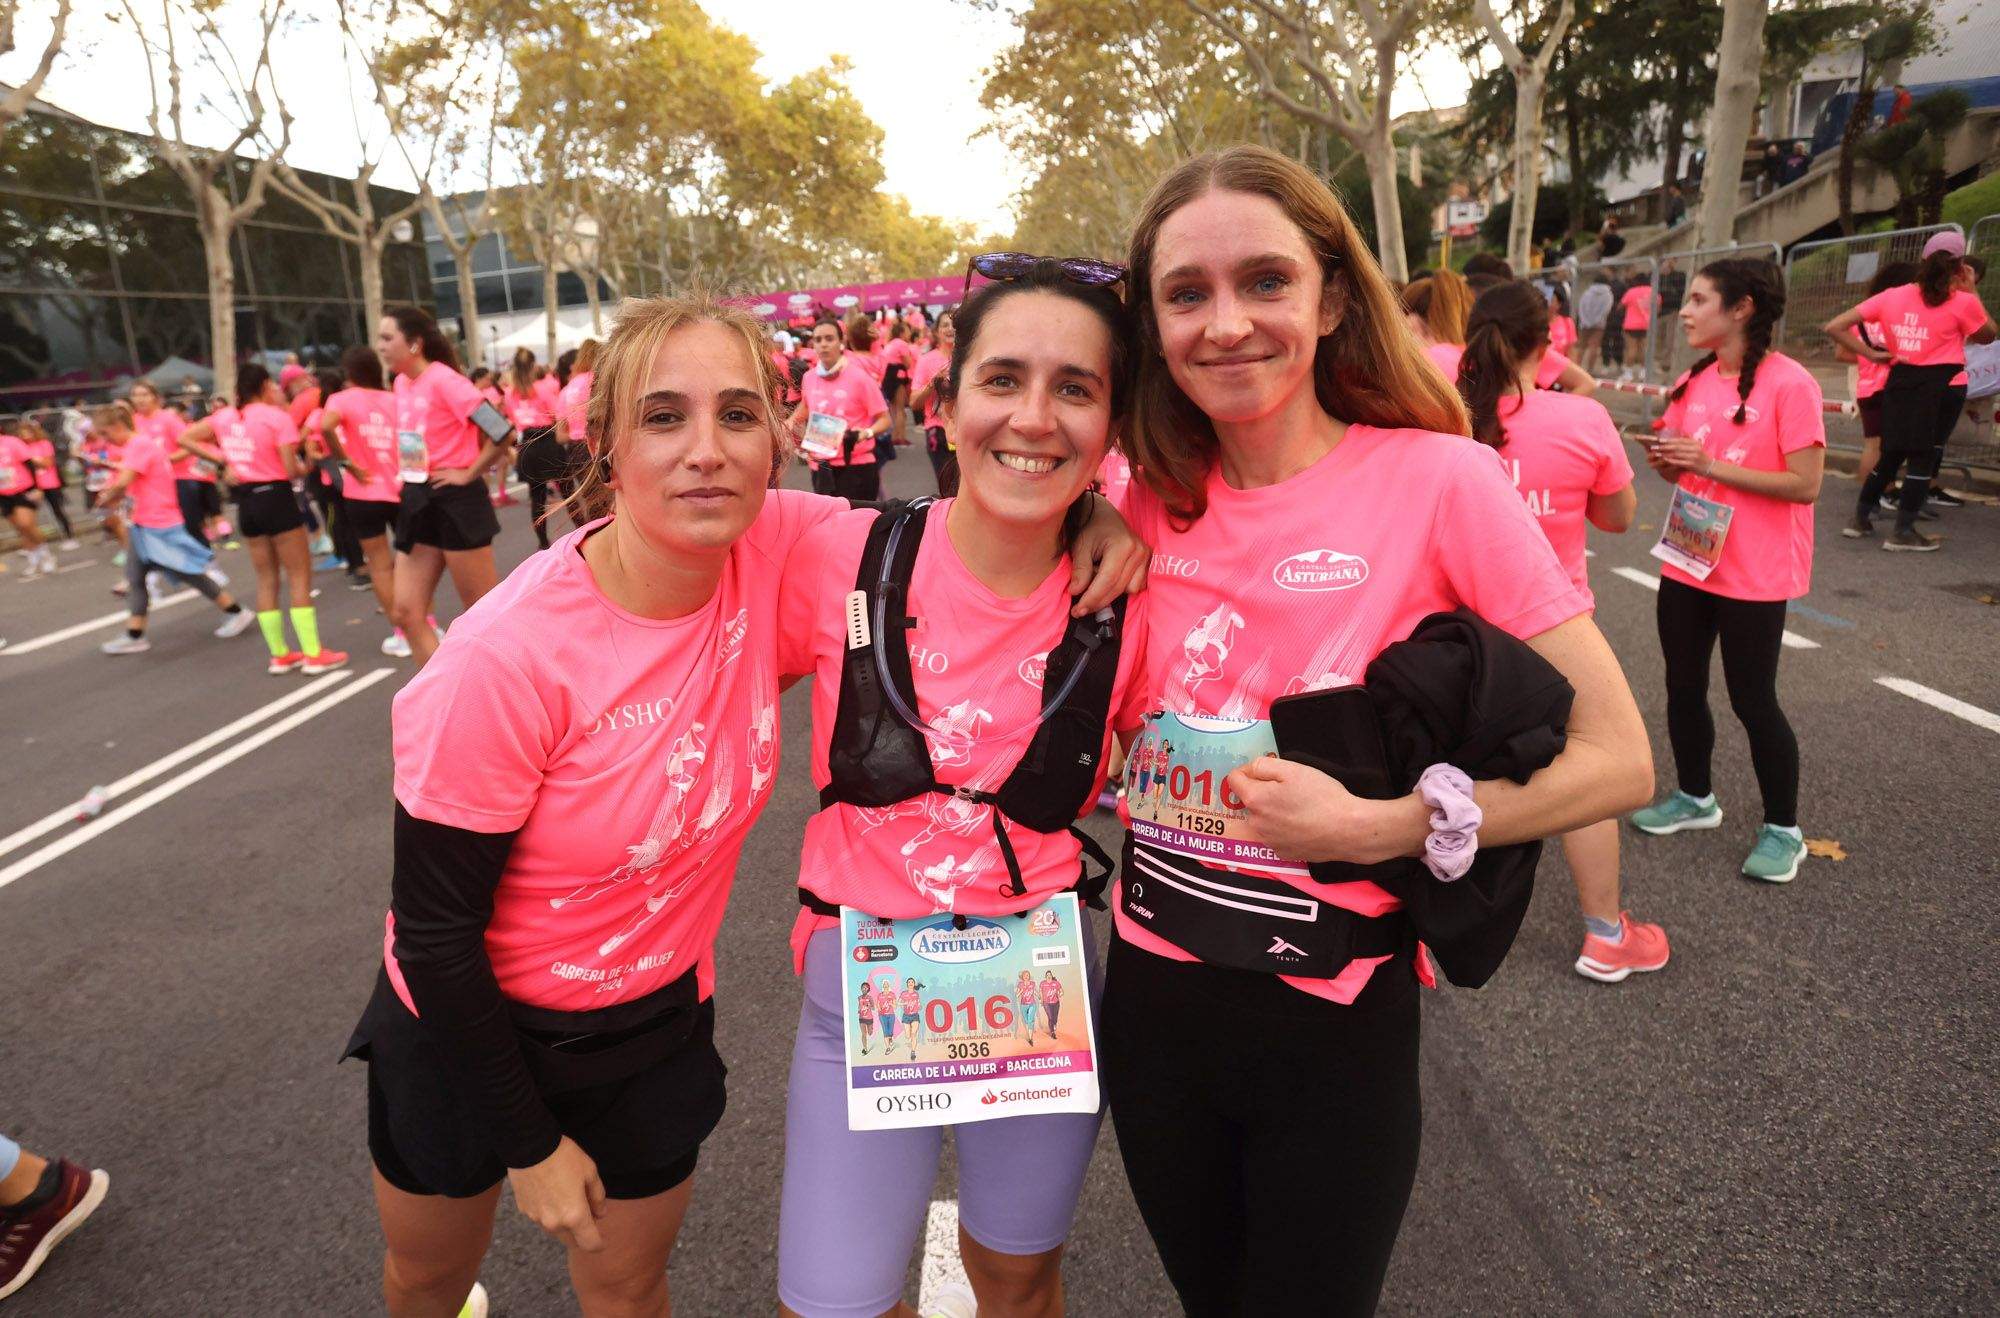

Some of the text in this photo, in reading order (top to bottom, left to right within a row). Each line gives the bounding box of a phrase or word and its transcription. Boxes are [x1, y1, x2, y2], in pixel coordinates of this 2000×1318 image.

[1177, 812, 1225, 836] 11529
[1132, 822, 1159, 840] ARRERA
[1161, 830, 1172, 843] DE
[1174, 832, 1186, 846] LA
[1188, 836, 1225, 854] MUJER
[857, 927, 895, 940] SUMA
[918, 934, 1005, 954] ASTURIANA
[550, 961, 606, 981] CARRERA
[608, 966, 623, 980] DE
[925, 994, 1014, 1034] 016
[947, 1041, 991, 1060] 3036
[873, 1055, 1072, 1081] CARRERA DE LA MUJER BARCELONA
[876, 1086, 1073, 1114] OYSHO Santander
